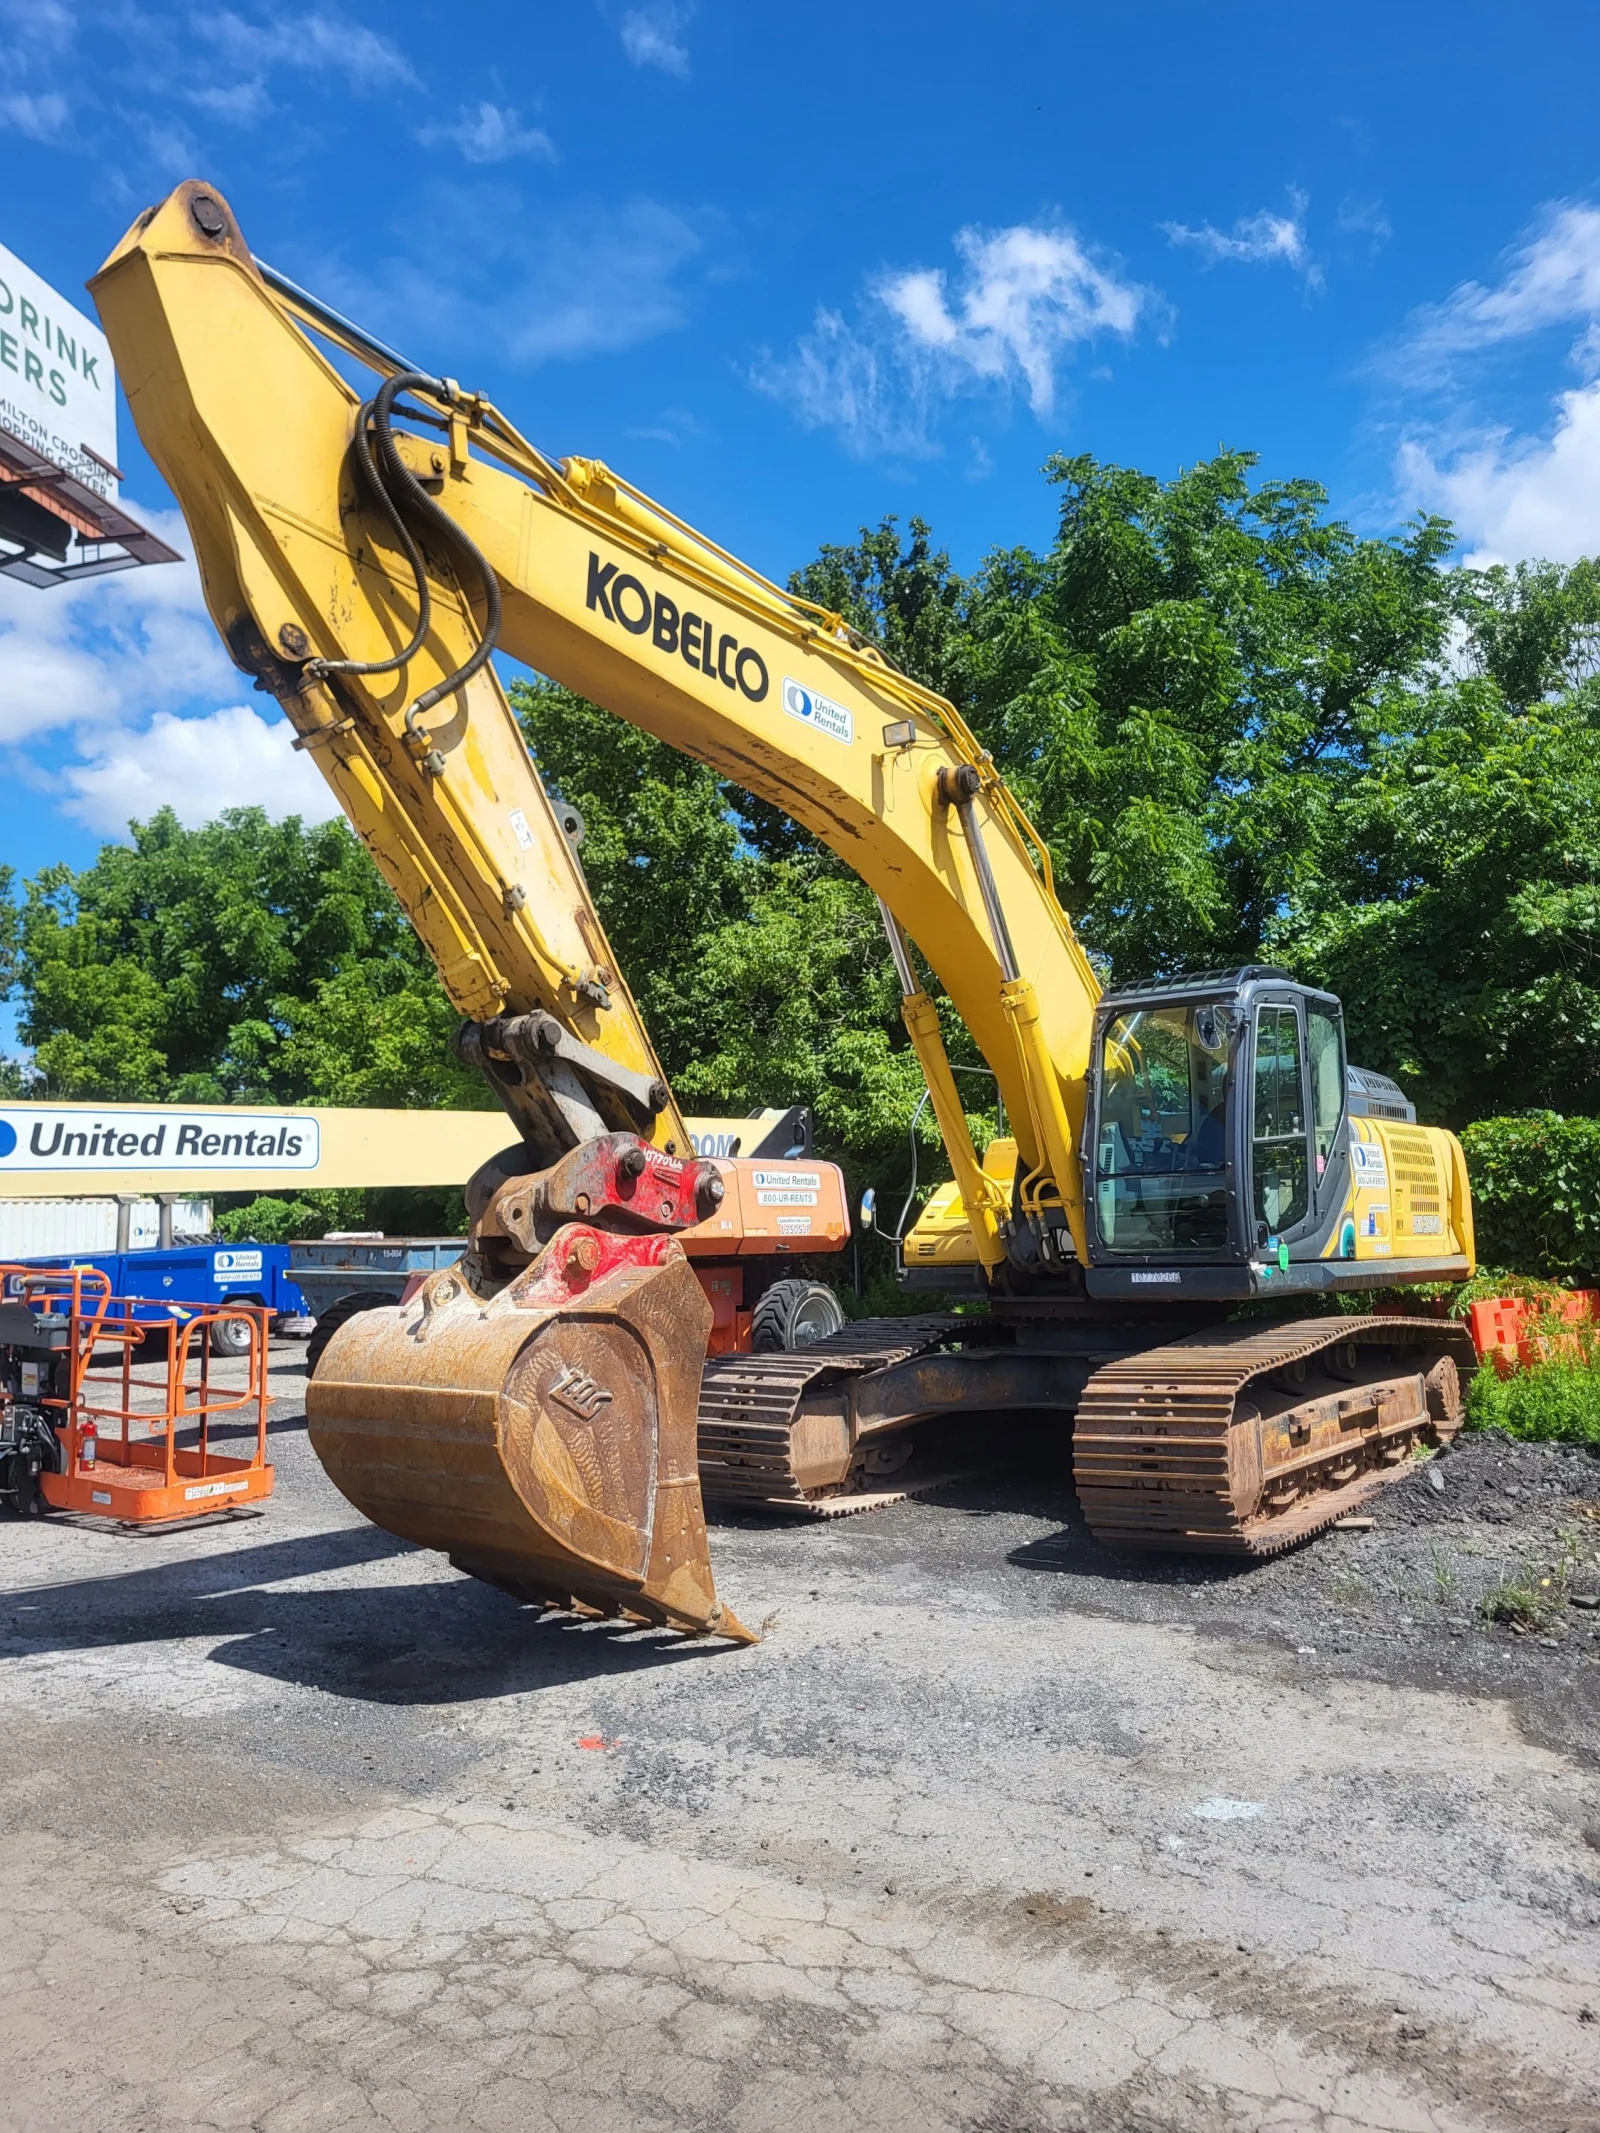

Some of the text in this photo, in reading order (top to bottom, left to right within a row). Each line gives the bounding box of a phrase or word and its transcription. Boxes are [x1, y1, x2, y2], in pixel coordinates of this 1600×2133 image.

[0, 328, 67, 407] ERS
[0, 412, 54, 461] OPPING
[585, 550, 769, 702] KOBELCO
[813, 711, 849, 738] Rentals
[814, 698, 847, 724] United
[29, 1122, 303, 1157] United Rentals
[766, 1174, 817, 1186] United Rentals
[235, 1260, 259, 1268] Rentals
